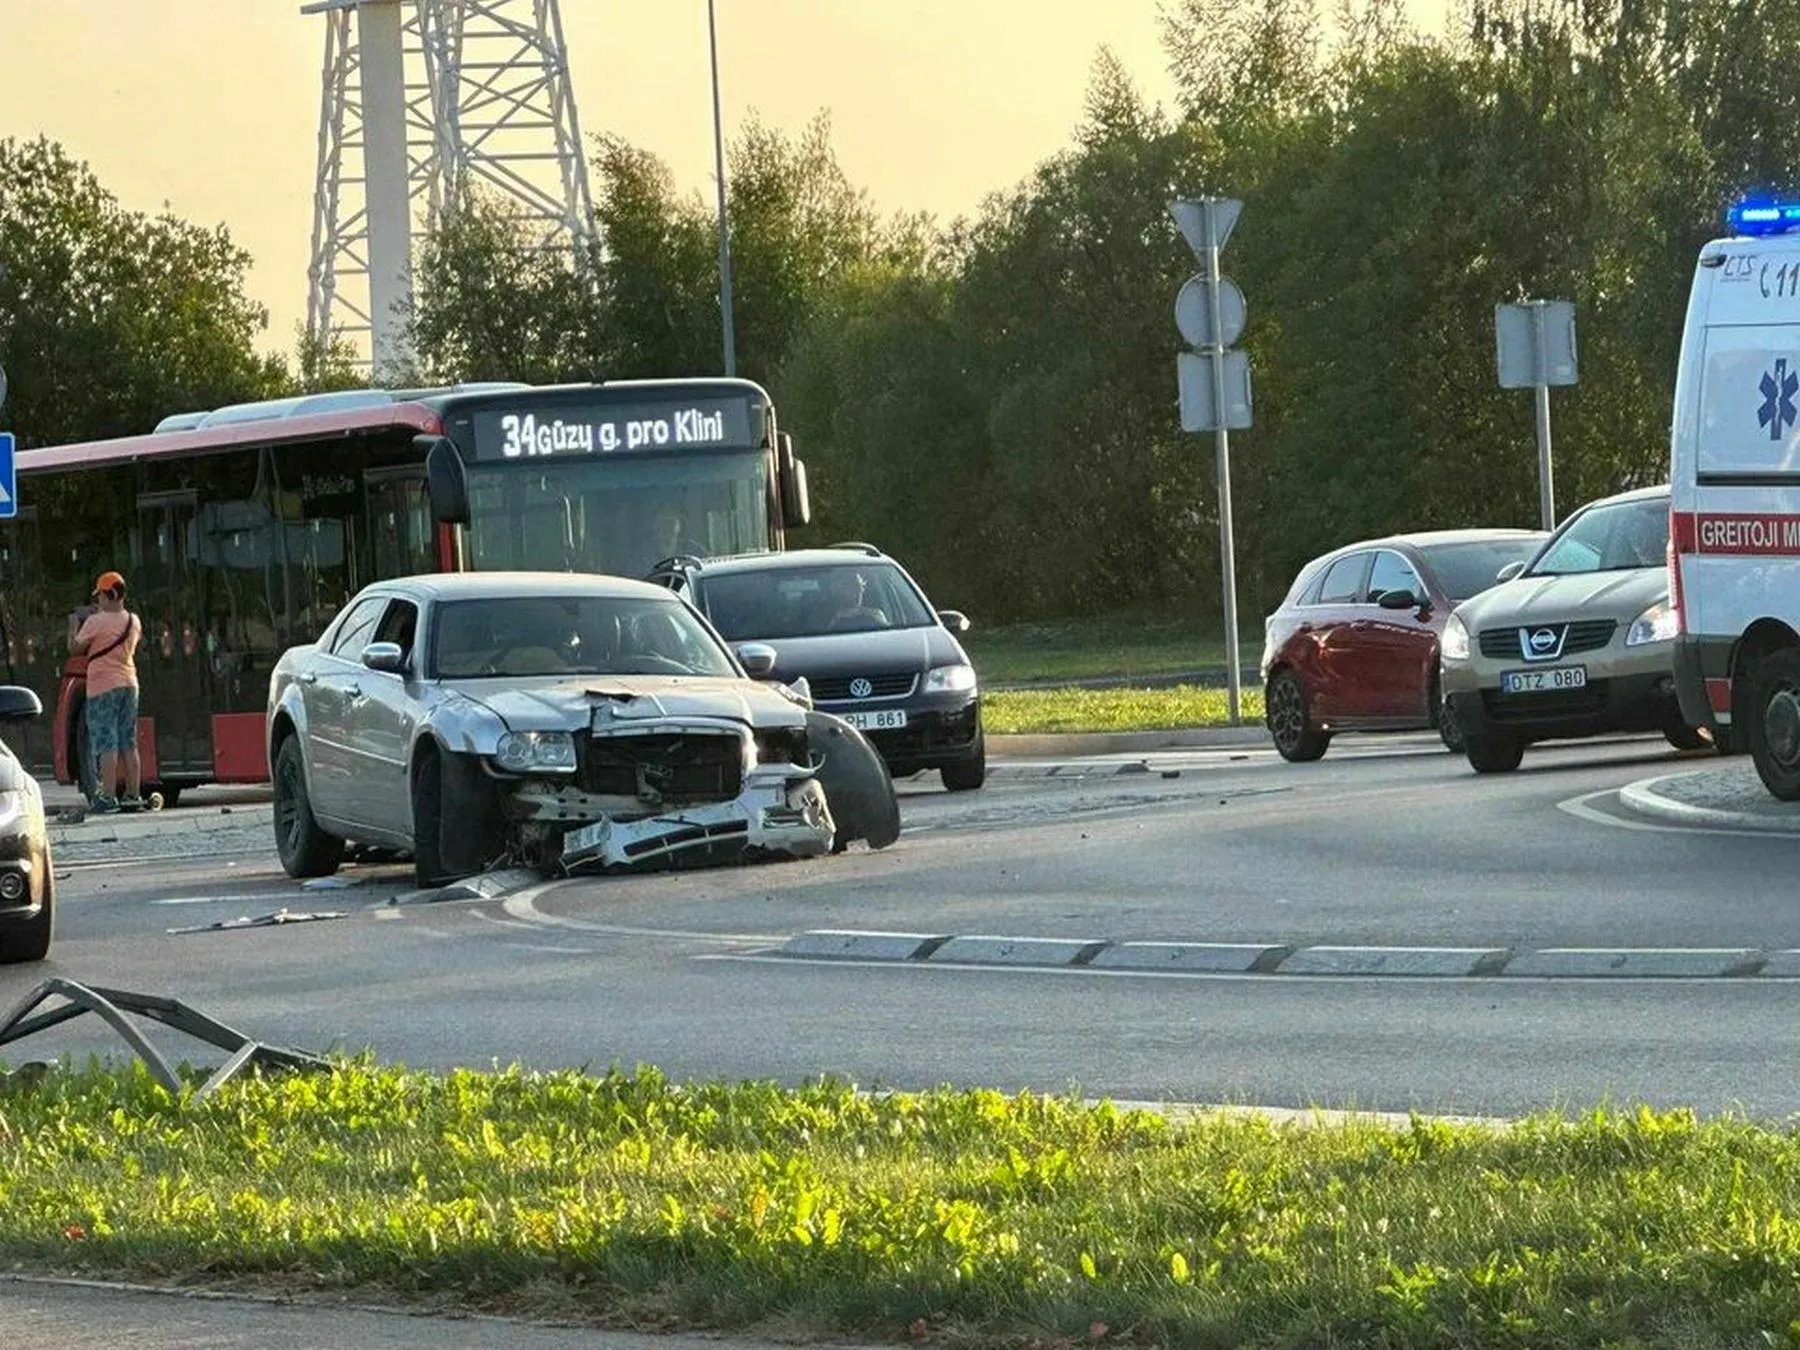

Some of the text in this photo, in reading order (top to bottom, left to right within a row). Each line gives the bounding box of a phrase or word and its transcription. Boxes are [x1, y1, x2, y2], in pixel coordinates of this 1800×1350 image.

[502, 414, 537, 456] 34
[599, 423, 622, 451] g.
[626, 419, 670, 449] pro
[674, 408, 723, 443] Klini
[1701, 520, 1778, 548] GREITOJI
[1555, 669, 1583, 687] 080
[877, 711, 904, 727] 861
